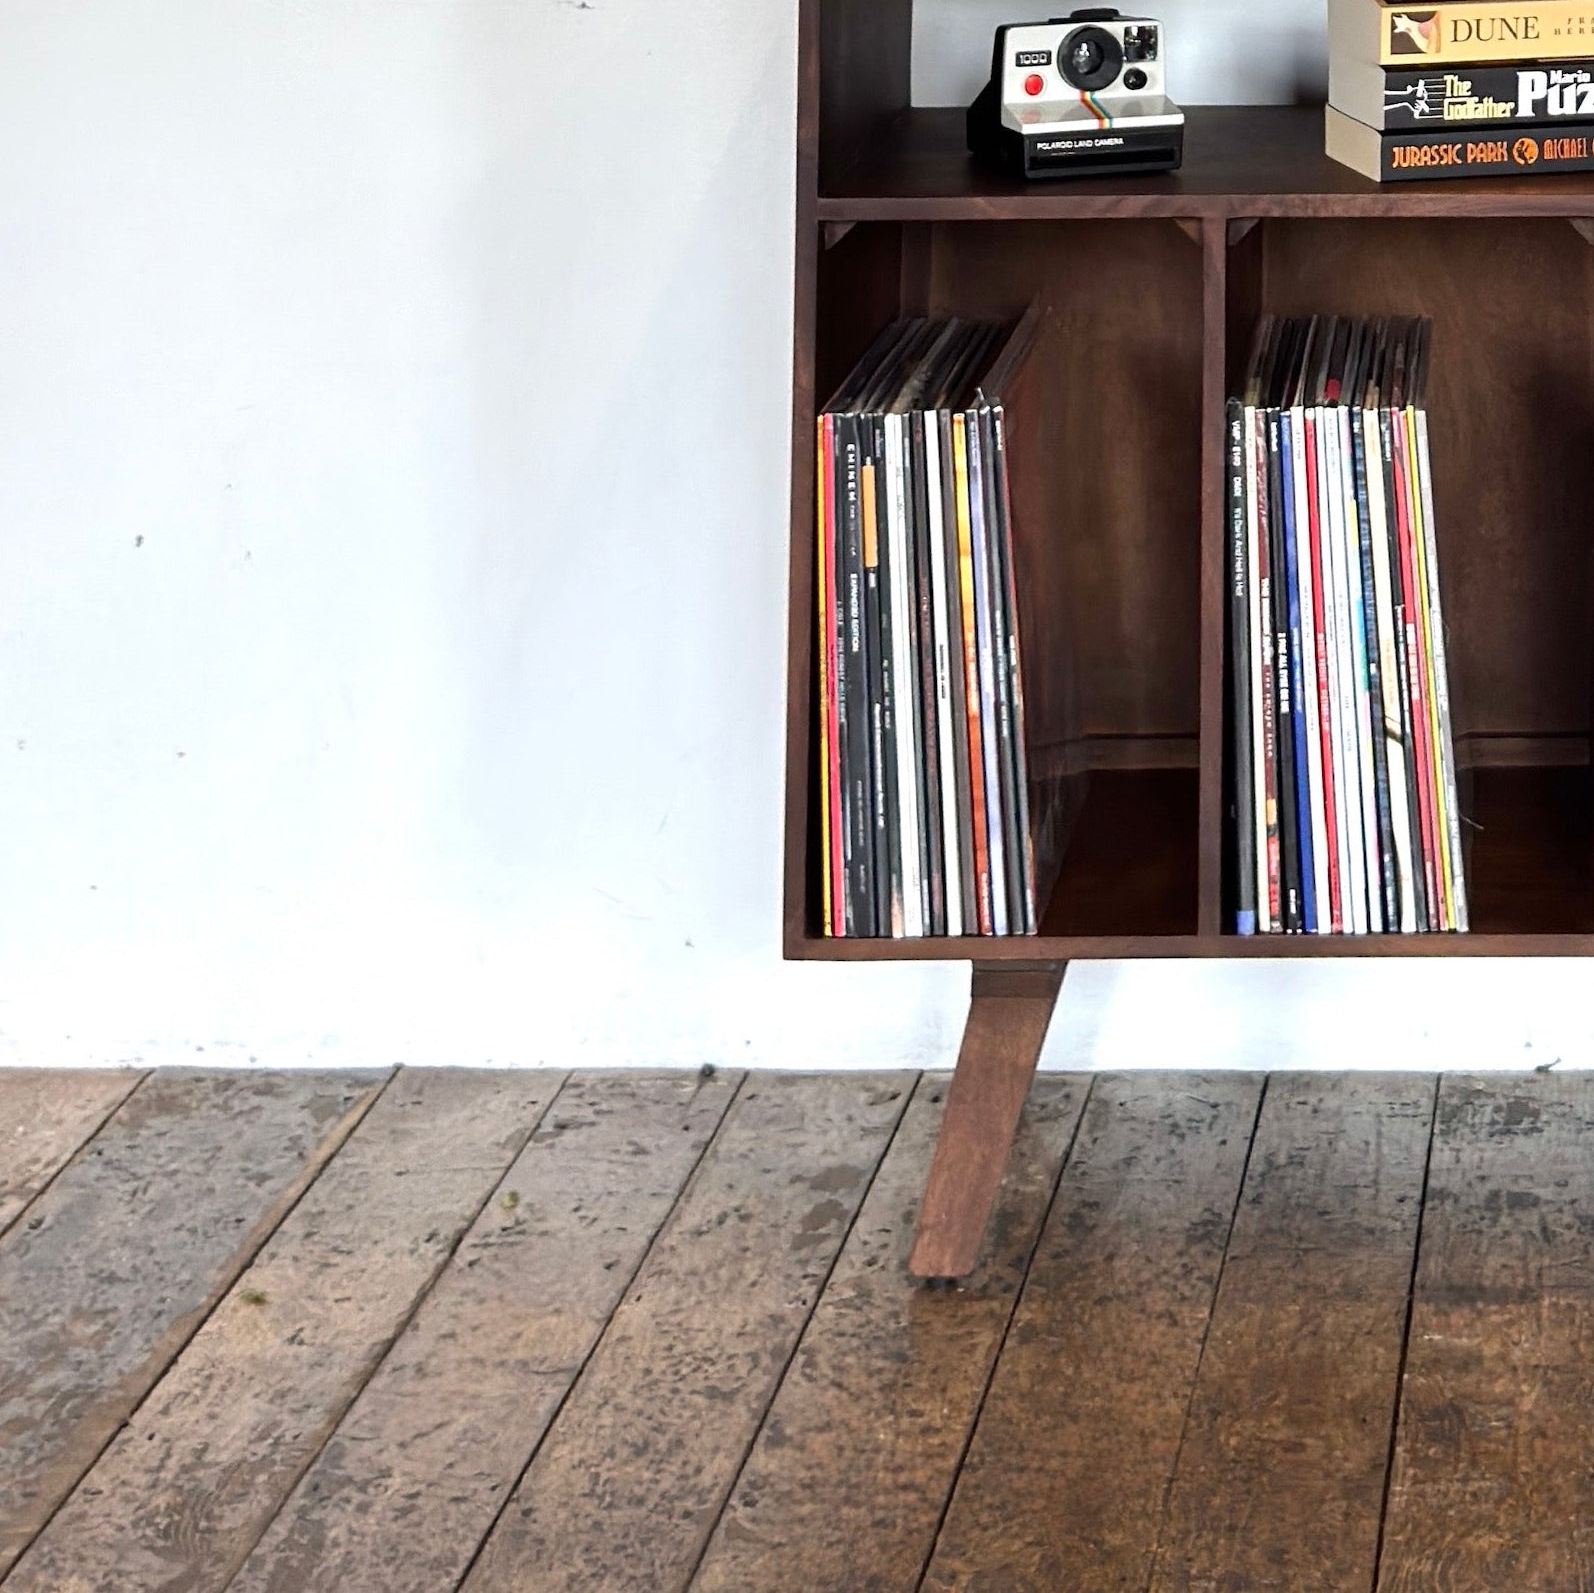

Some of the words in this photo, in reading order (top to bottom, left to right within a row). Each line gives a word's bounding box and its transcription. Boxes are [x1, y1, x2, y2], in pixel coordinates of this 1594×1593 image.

[1450, 16, 1540, 43] DUNE
[1443, 74, 1472, 97] The
[1550, 69, 1591, 84] Mario
[1443, 96, 1516, 121] Godfather
[1036, 140, 1073, 150] POLAROID
[1073, 139, 1093, 148] LAND
[1094, 137, 1124, 147] CAMERA
[1392, 143, 1462, 169] JURASSIC
[1466, 141, 1508, 164] PARK
[1543, 137, 1588, 160] MICHAEL
[846, 443, 856, 502] EMINEM
[1234, 520, 1242, 538] Dark
[1234, 540, 1242, 556] And
